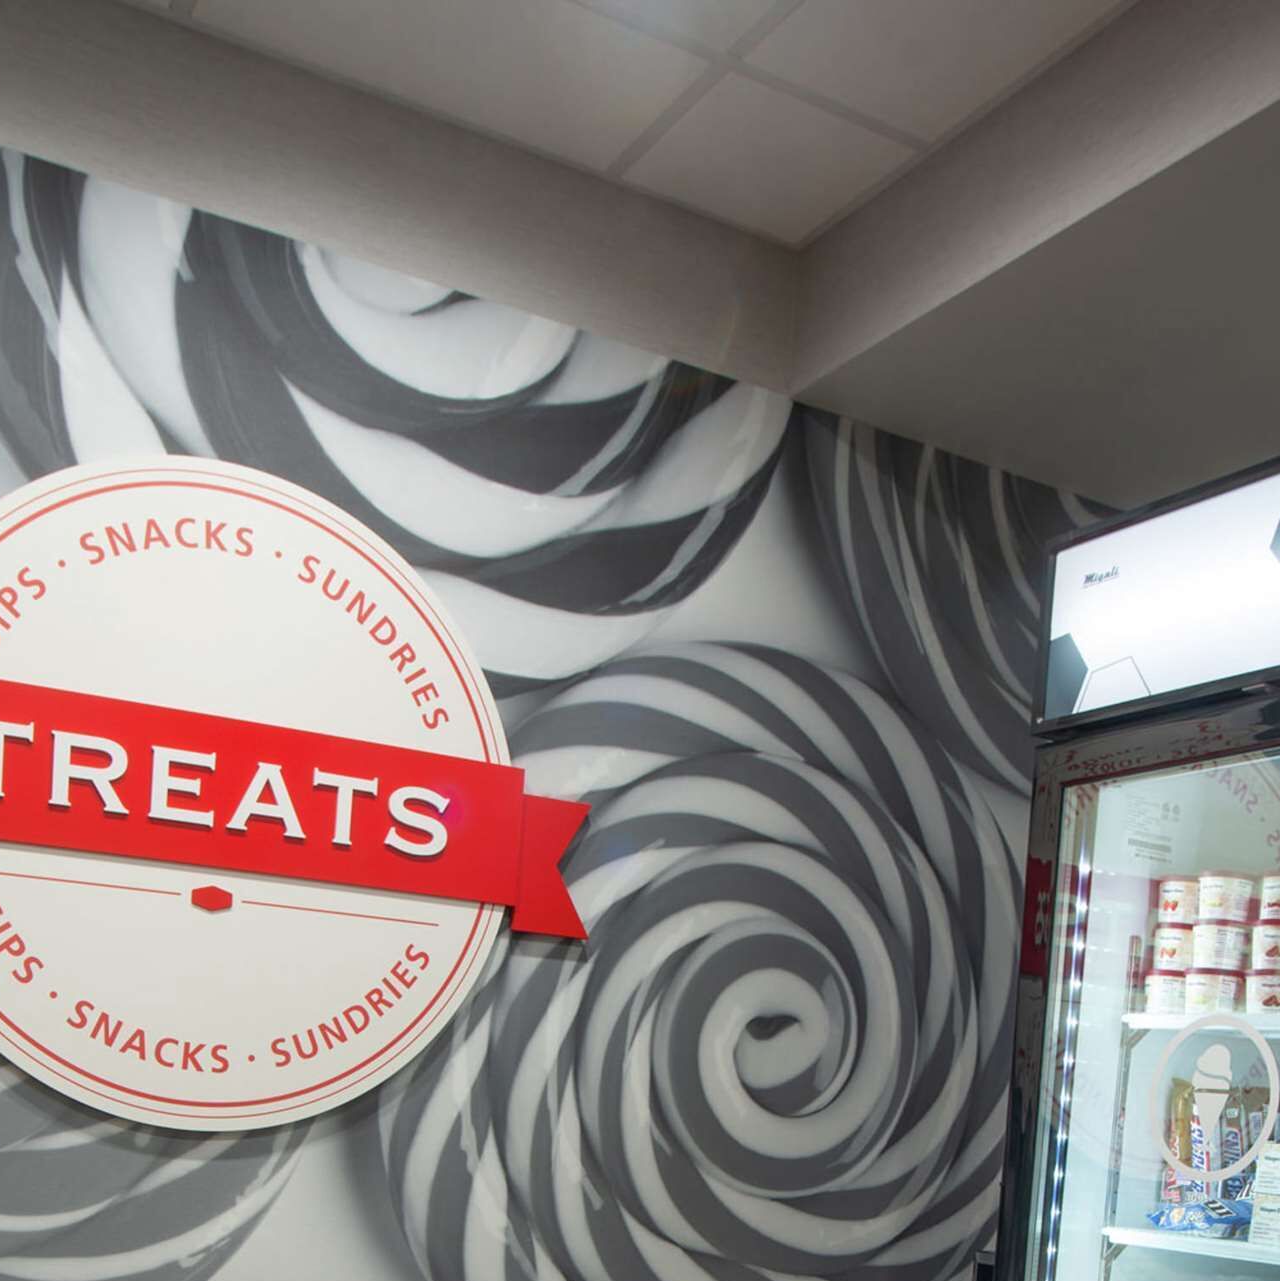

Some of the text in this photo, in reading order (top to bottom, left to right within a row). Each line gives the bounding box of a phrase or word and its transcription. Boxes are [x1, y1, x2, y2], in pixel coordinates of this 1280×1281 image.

[78, 516, 255, 567] SNACKS
[296, 554, 450, 732] SUNDRIES
[66, 997, 231, 1074] SNACKS
[269, 941, 433, 1069] SUNDRIES
